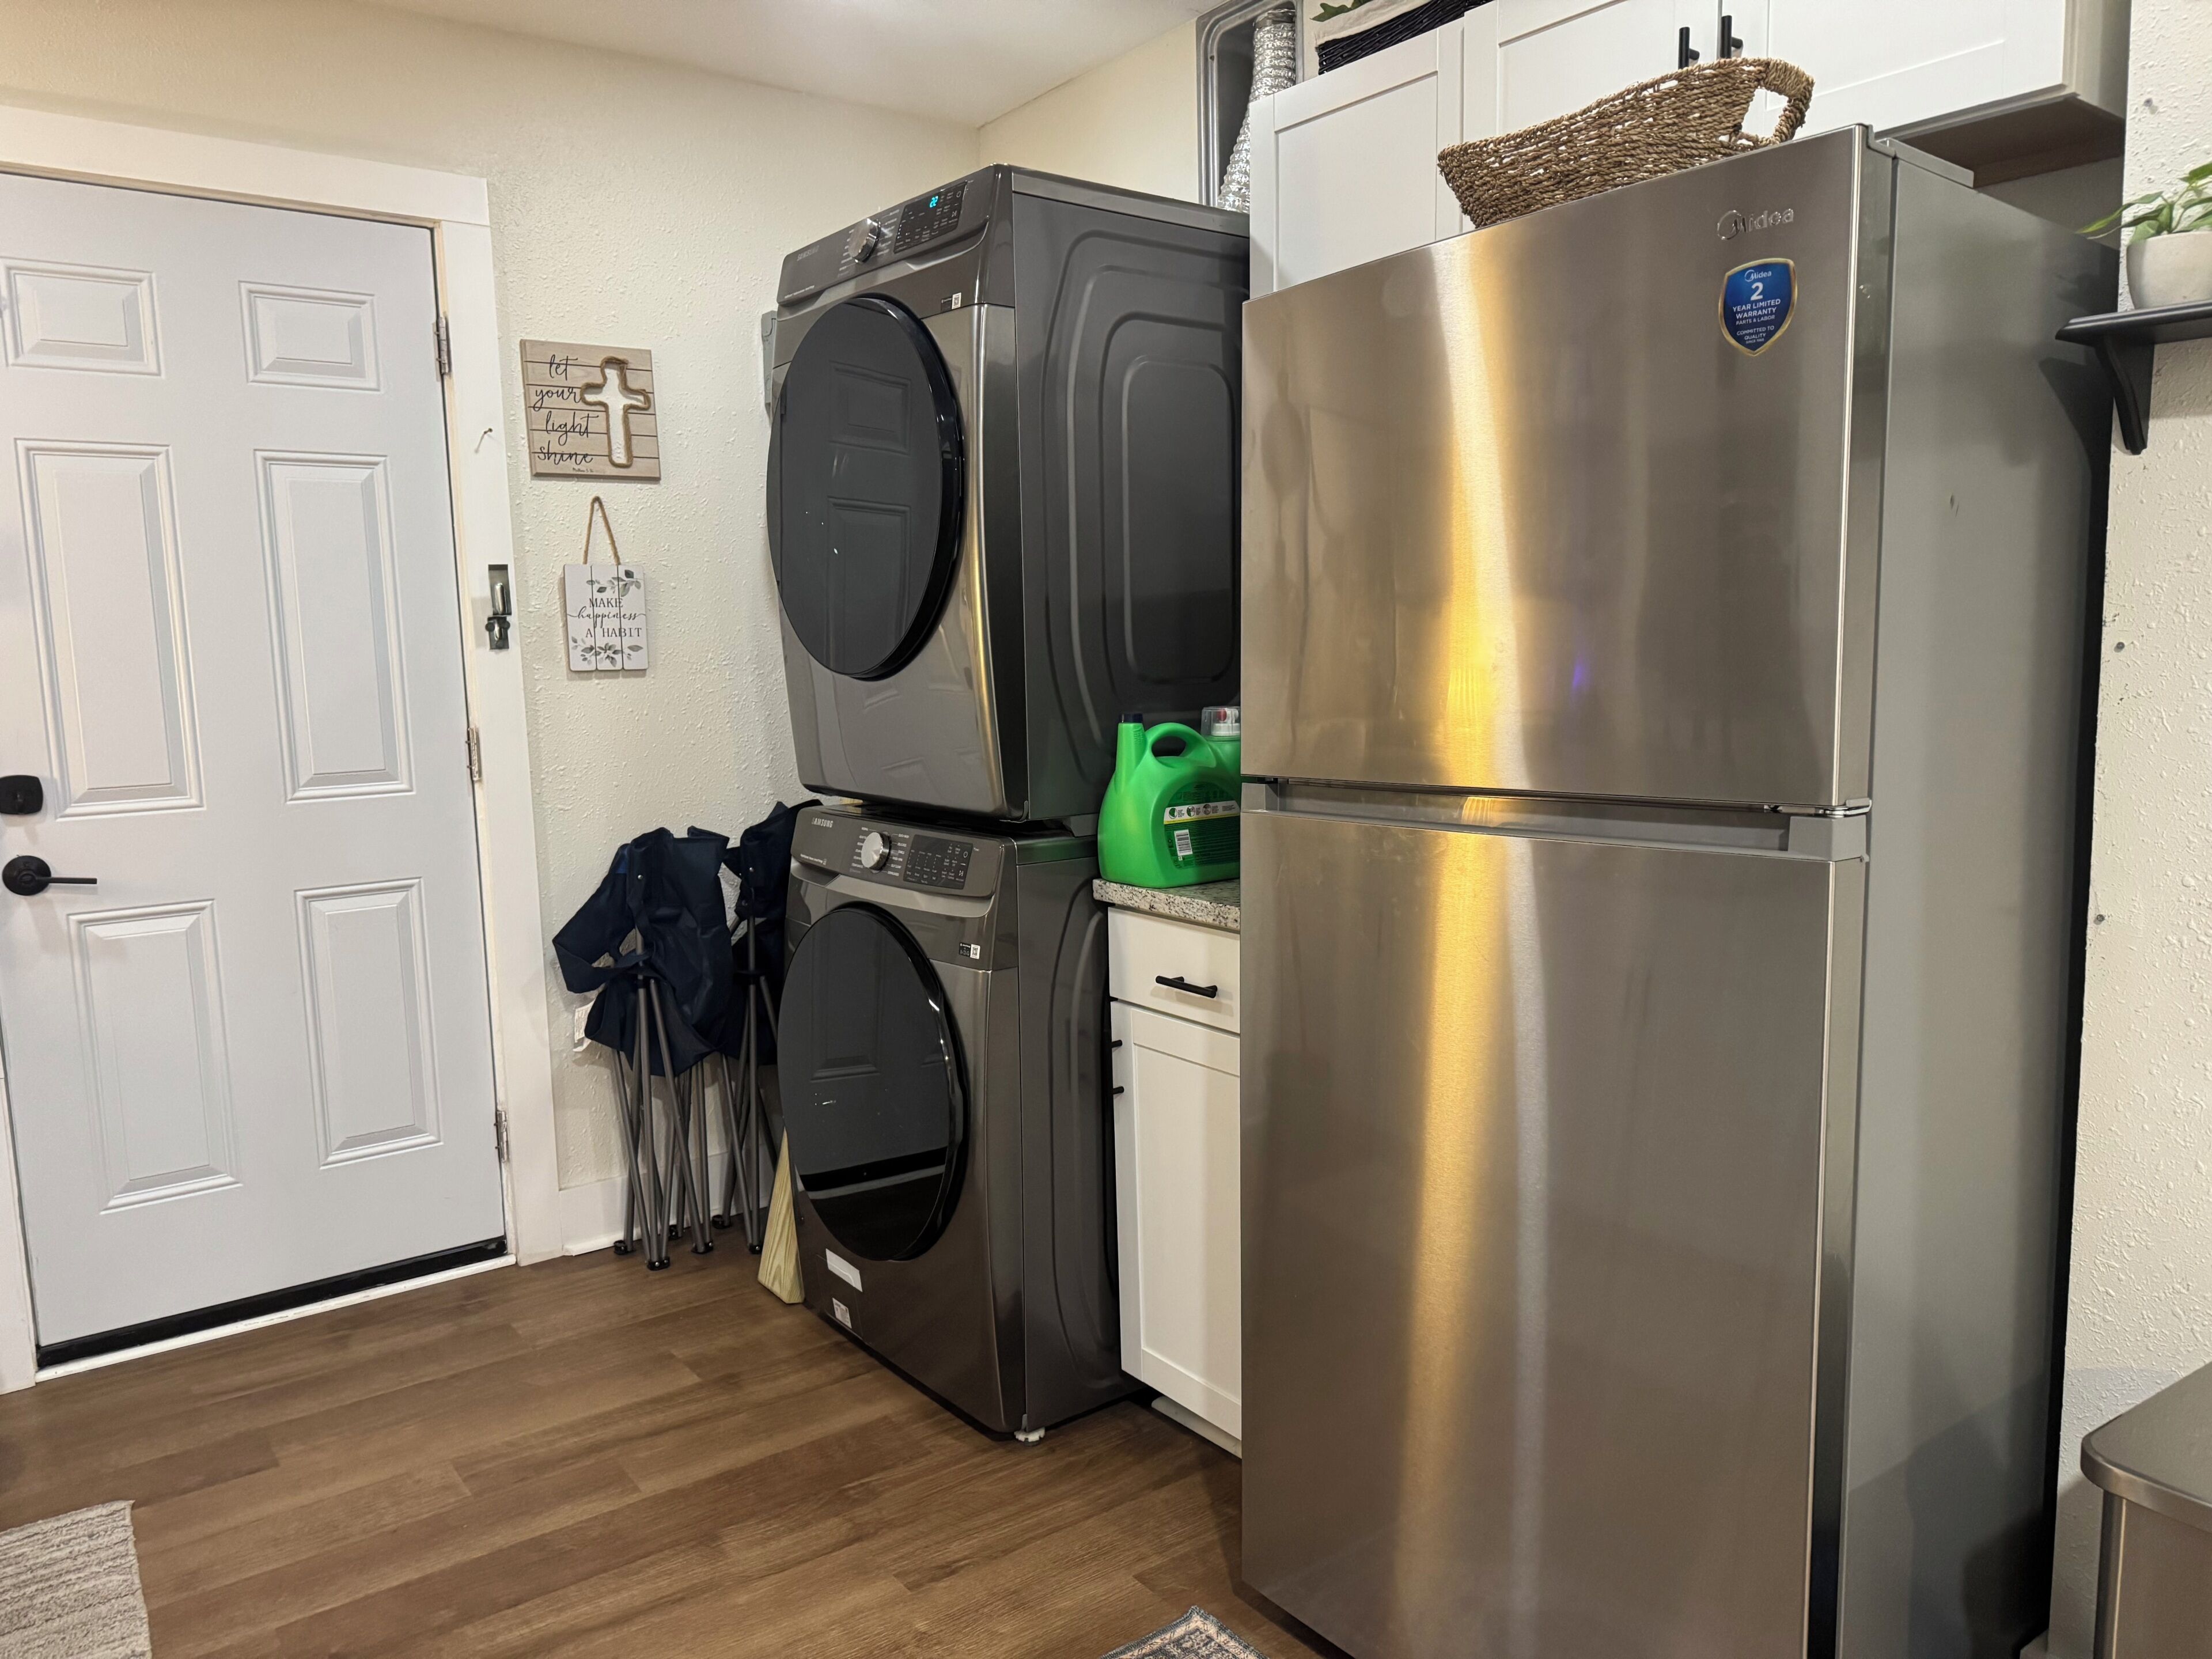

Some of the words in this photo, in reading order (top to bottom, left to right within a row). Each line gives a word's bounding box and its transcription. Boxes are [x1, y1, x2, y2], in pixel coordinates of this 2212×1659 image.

[1717, 208, 1794, 240] Midea
[1744, 270, 1771, 282] Midea
[1750, 282, 1763, 301] 2
[1733, 304, 1751, 312] YEAR
[1753, 298, 1781, 309] LIMITED
[1736, 307, 1777, 319] WARRANTY
[1736, 327, 1766, 336] COMMITTED
[1744, 332, 1766, 340] QUALITY
[549, 354, 578, 381] let
[533, 387, 582, 411] your
[546, 411, 599, 446] light
[537, 440, 593, 465] shine
[589, 597, 624, 608] MAKE
[567, 606, 646, 629] happiness
[585, 628, 593, 638] A
[603, 627, 642, 638] HABIT
[812, 817, 834, 828] SAMSUNG
